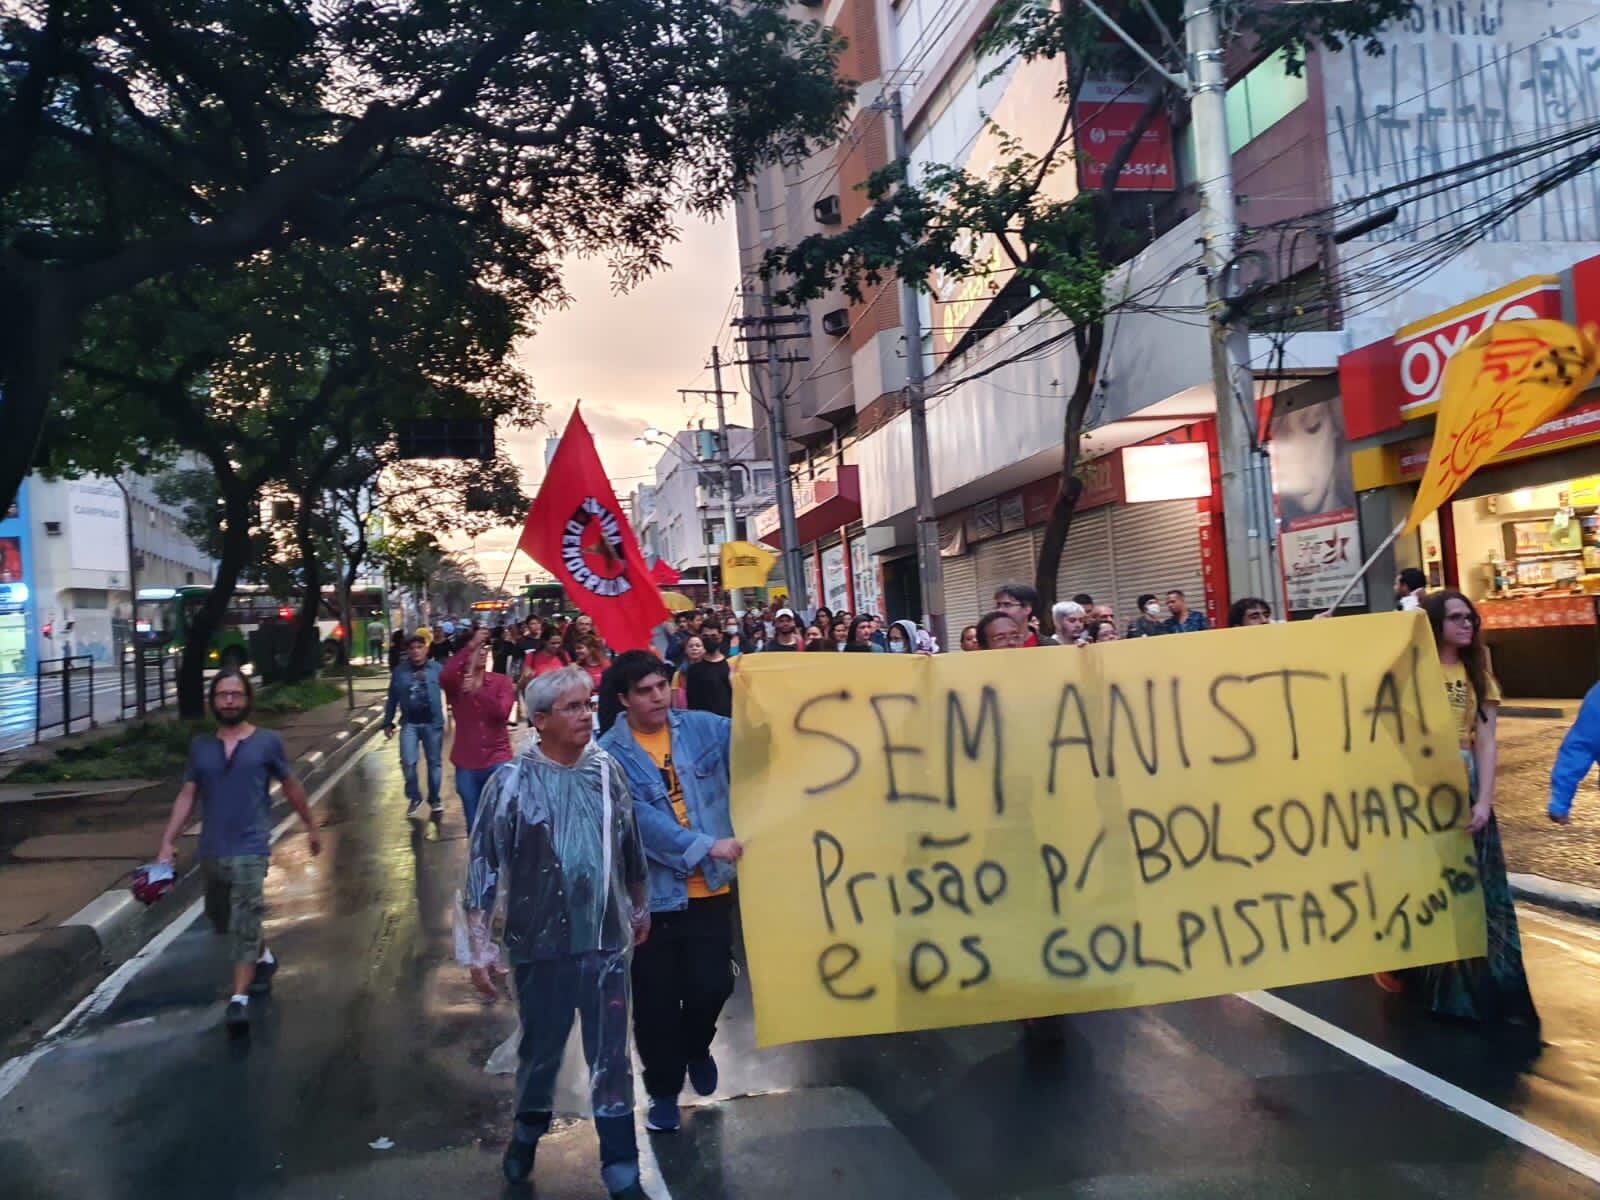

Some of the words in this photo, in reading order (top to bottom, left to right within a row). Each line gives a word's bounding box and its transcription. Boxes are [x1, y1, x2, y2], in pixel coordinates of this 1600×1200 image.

[1402, 304, 1538, 396] OX
[793, 684, 1004, 814] SEM
[1047, 647, 1434, 793] ANISTIA!
[812, 830, 1009, 933] Prisão
[1128, 781, 1462, 885] BOLSONARO
[816, 942, 877, 1001] e
